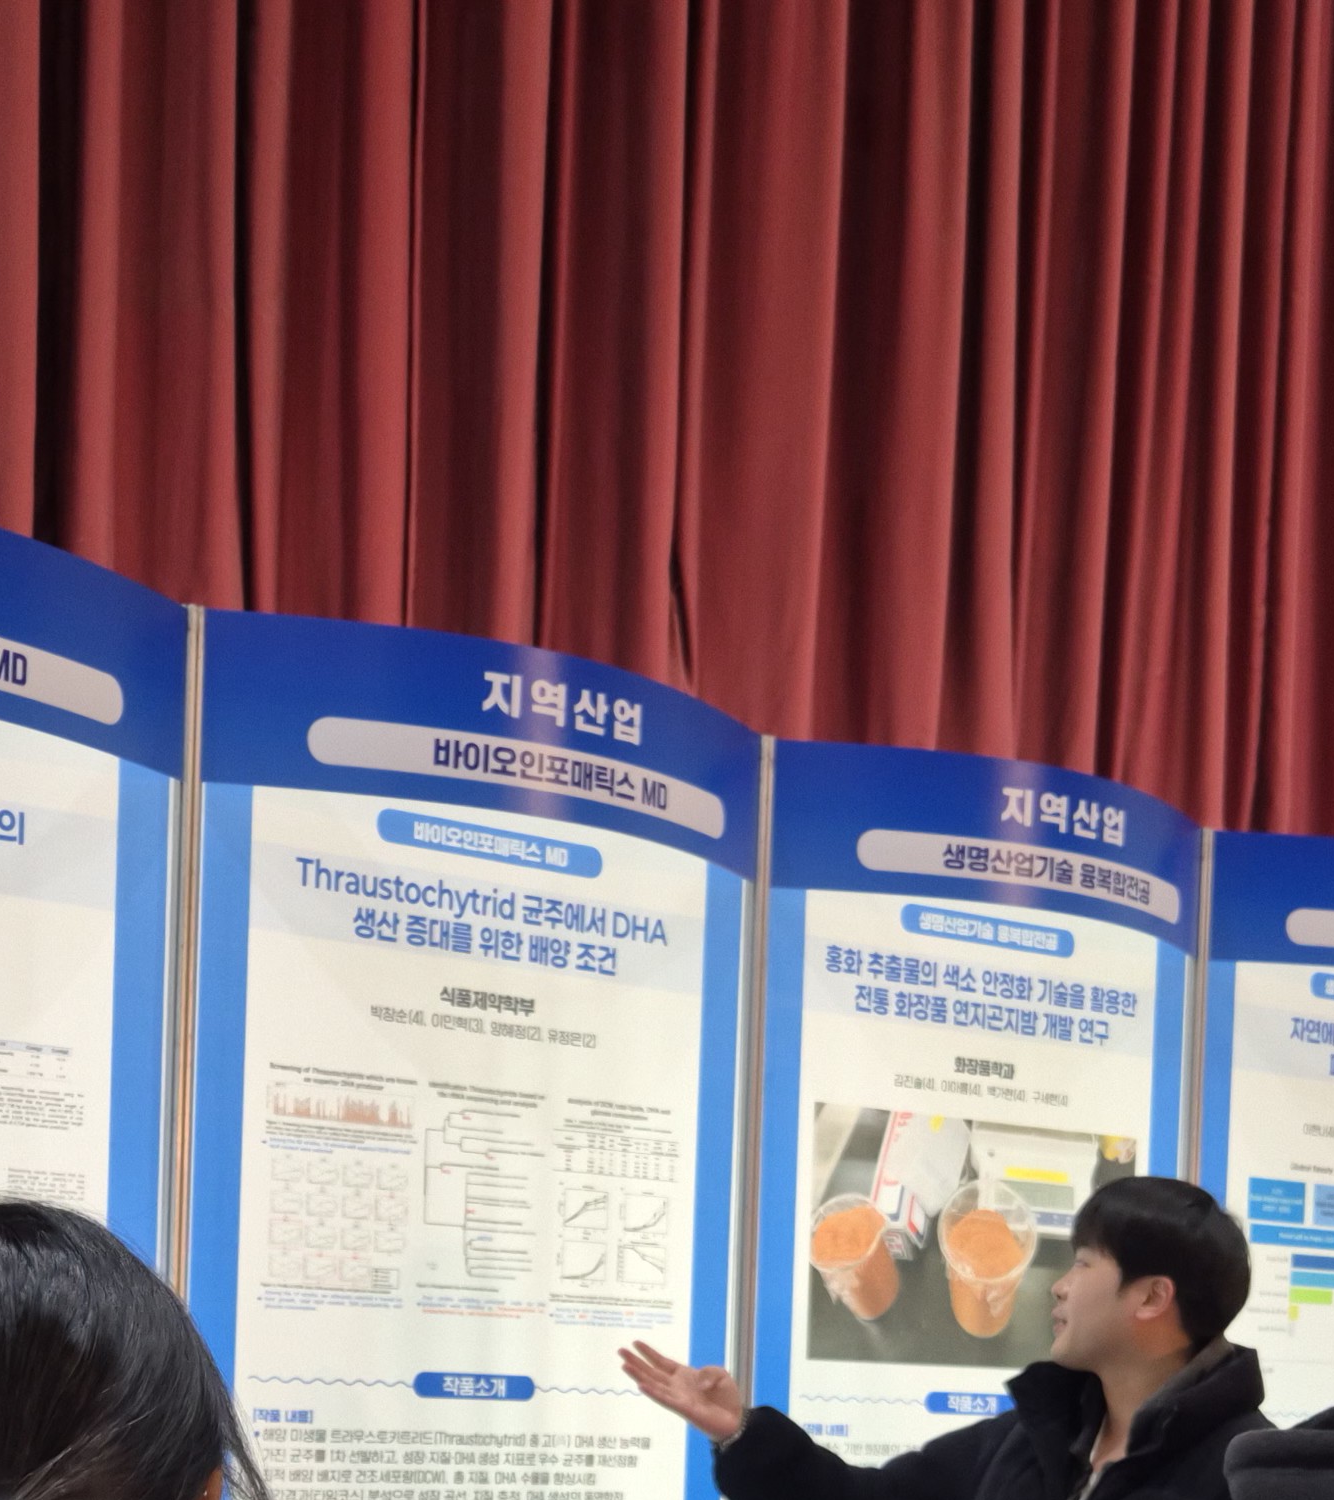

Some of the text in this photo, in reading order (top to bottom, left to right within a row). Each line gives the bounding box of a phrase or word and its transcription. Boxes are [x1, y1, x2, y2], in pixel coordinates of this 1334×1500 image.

[481, 670, 643, 746] 지역산업
[433, 737, 669, 811] 바이오인포매틱스 MD
[1000, 786, 1126, 847] 지역산업
[545, 844, 569, 869] MD
[942, 842, 1151, 905] 생명산업기술 융복합전공
[295, 856, 668, 947] Thraustochytrid 균주에서 DHA
[353, 907, 617, 977] 생산 증대를 위한 배양 조건
[824, 944, 1137, 1019] 홍화 추출물의 색소 안정화 기술을 활용한
[854, 983, 891, 1016] 전통
[894, 990, 947, 1025] 화장품
[1042, 1008, 1073, 1042] 개발
[1078, 1015, 1110, 1046] 연구
[442, 1376, 507, 1399] 작품소개
